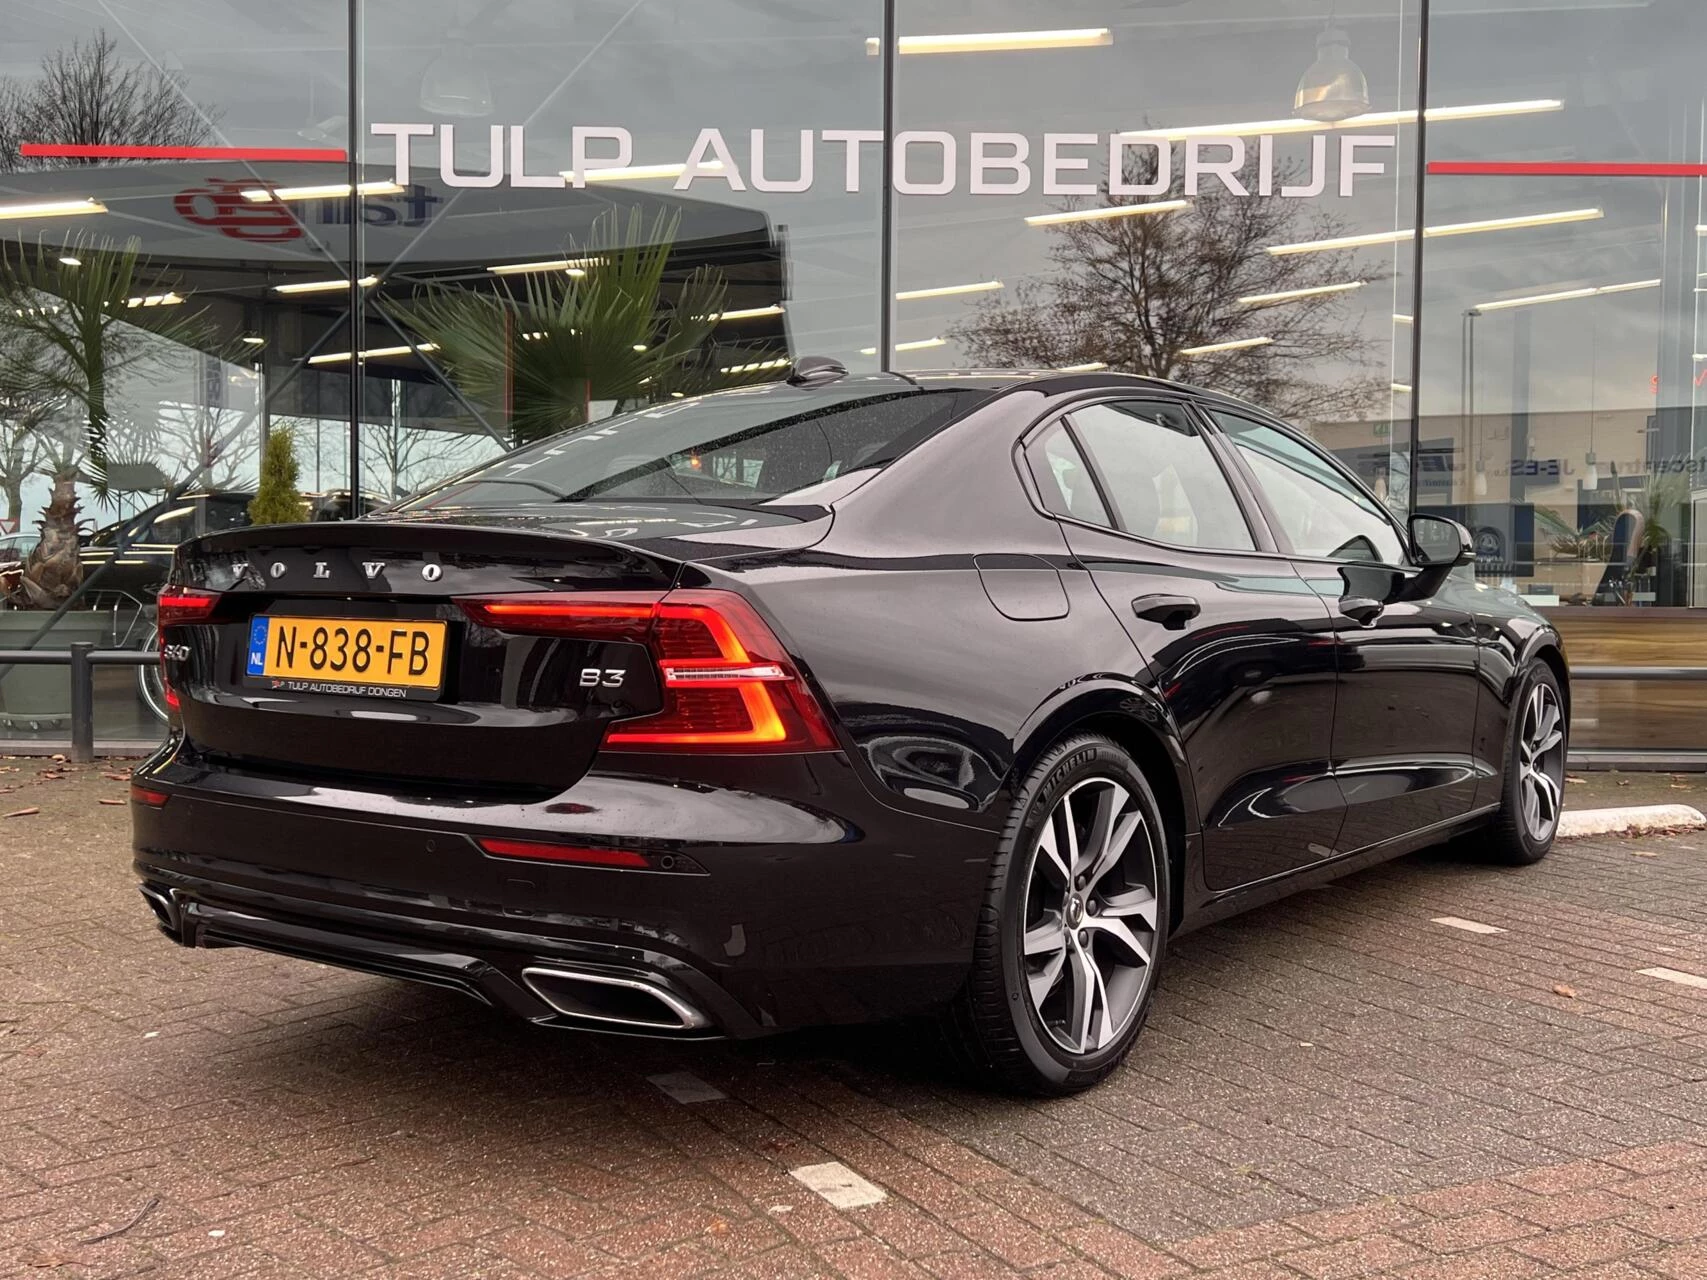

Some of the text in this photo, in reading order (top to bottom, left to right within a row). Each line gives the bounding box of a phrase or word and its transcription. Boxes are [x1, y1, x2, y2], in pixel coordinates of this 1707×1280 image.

[370, 123, 1396, 197] TULP AUTOBEDRIJF
[232, 562, 442, 581] VOLVO
[251, 653, 263, 665] NL
[276, 626, 430, 675] N-838-FB
[579, 668, 626, 687] B3
[288, 682, 308, 691] TULP
[310, 683, 367, 694] AUTOBEDRIJF
[369, 688, 406, 698] DONGEN
